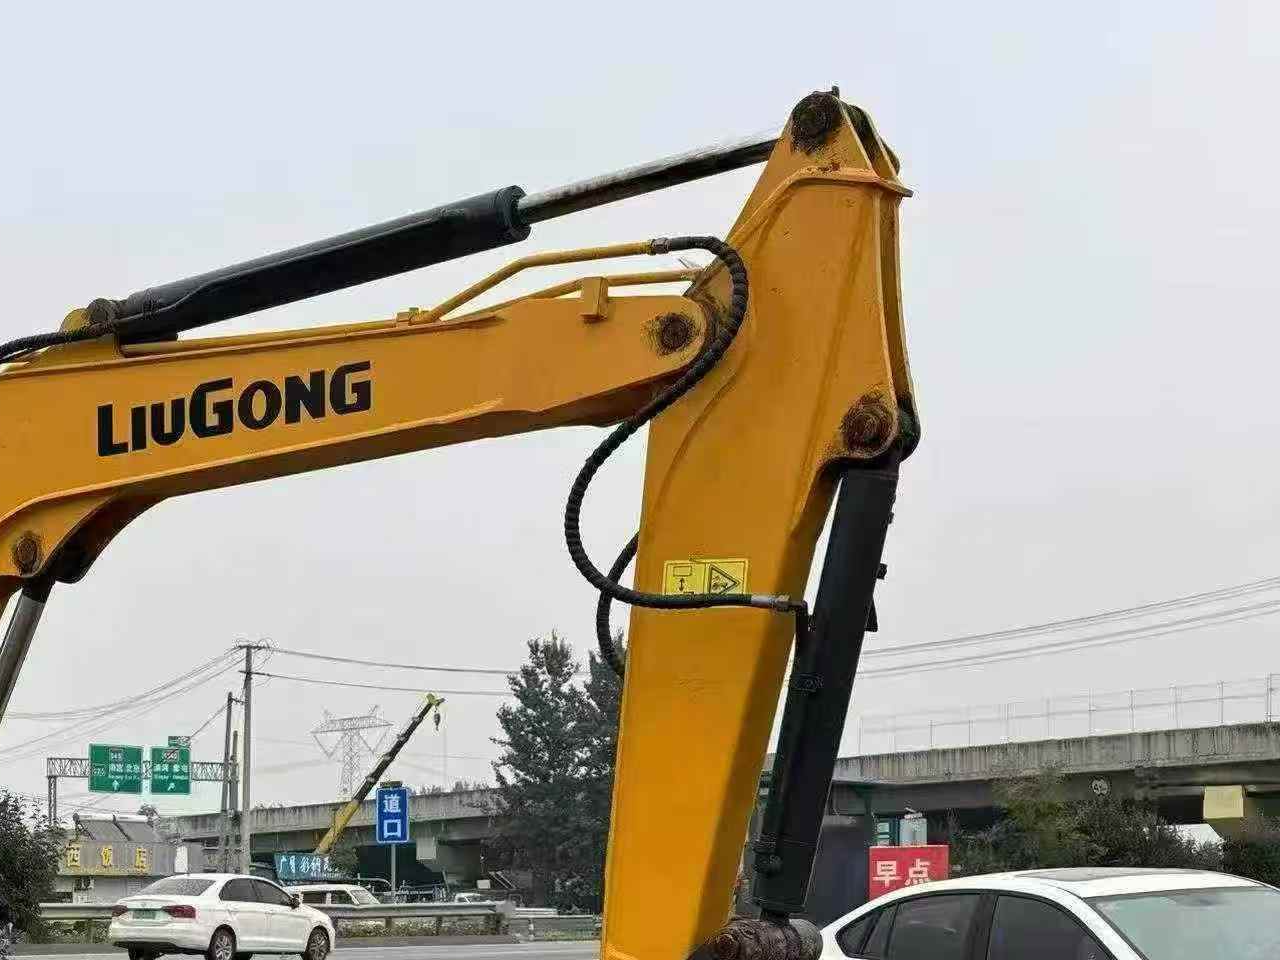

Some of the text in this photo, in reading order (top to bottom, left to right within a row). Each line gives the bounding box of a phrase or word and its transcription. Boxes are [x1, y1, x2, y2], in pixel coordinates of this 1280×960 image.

[97, 360, 371, 456] LIUGONG
[383, 793, 402, 839] 道口
[872, 858, 931, 888] 早点
